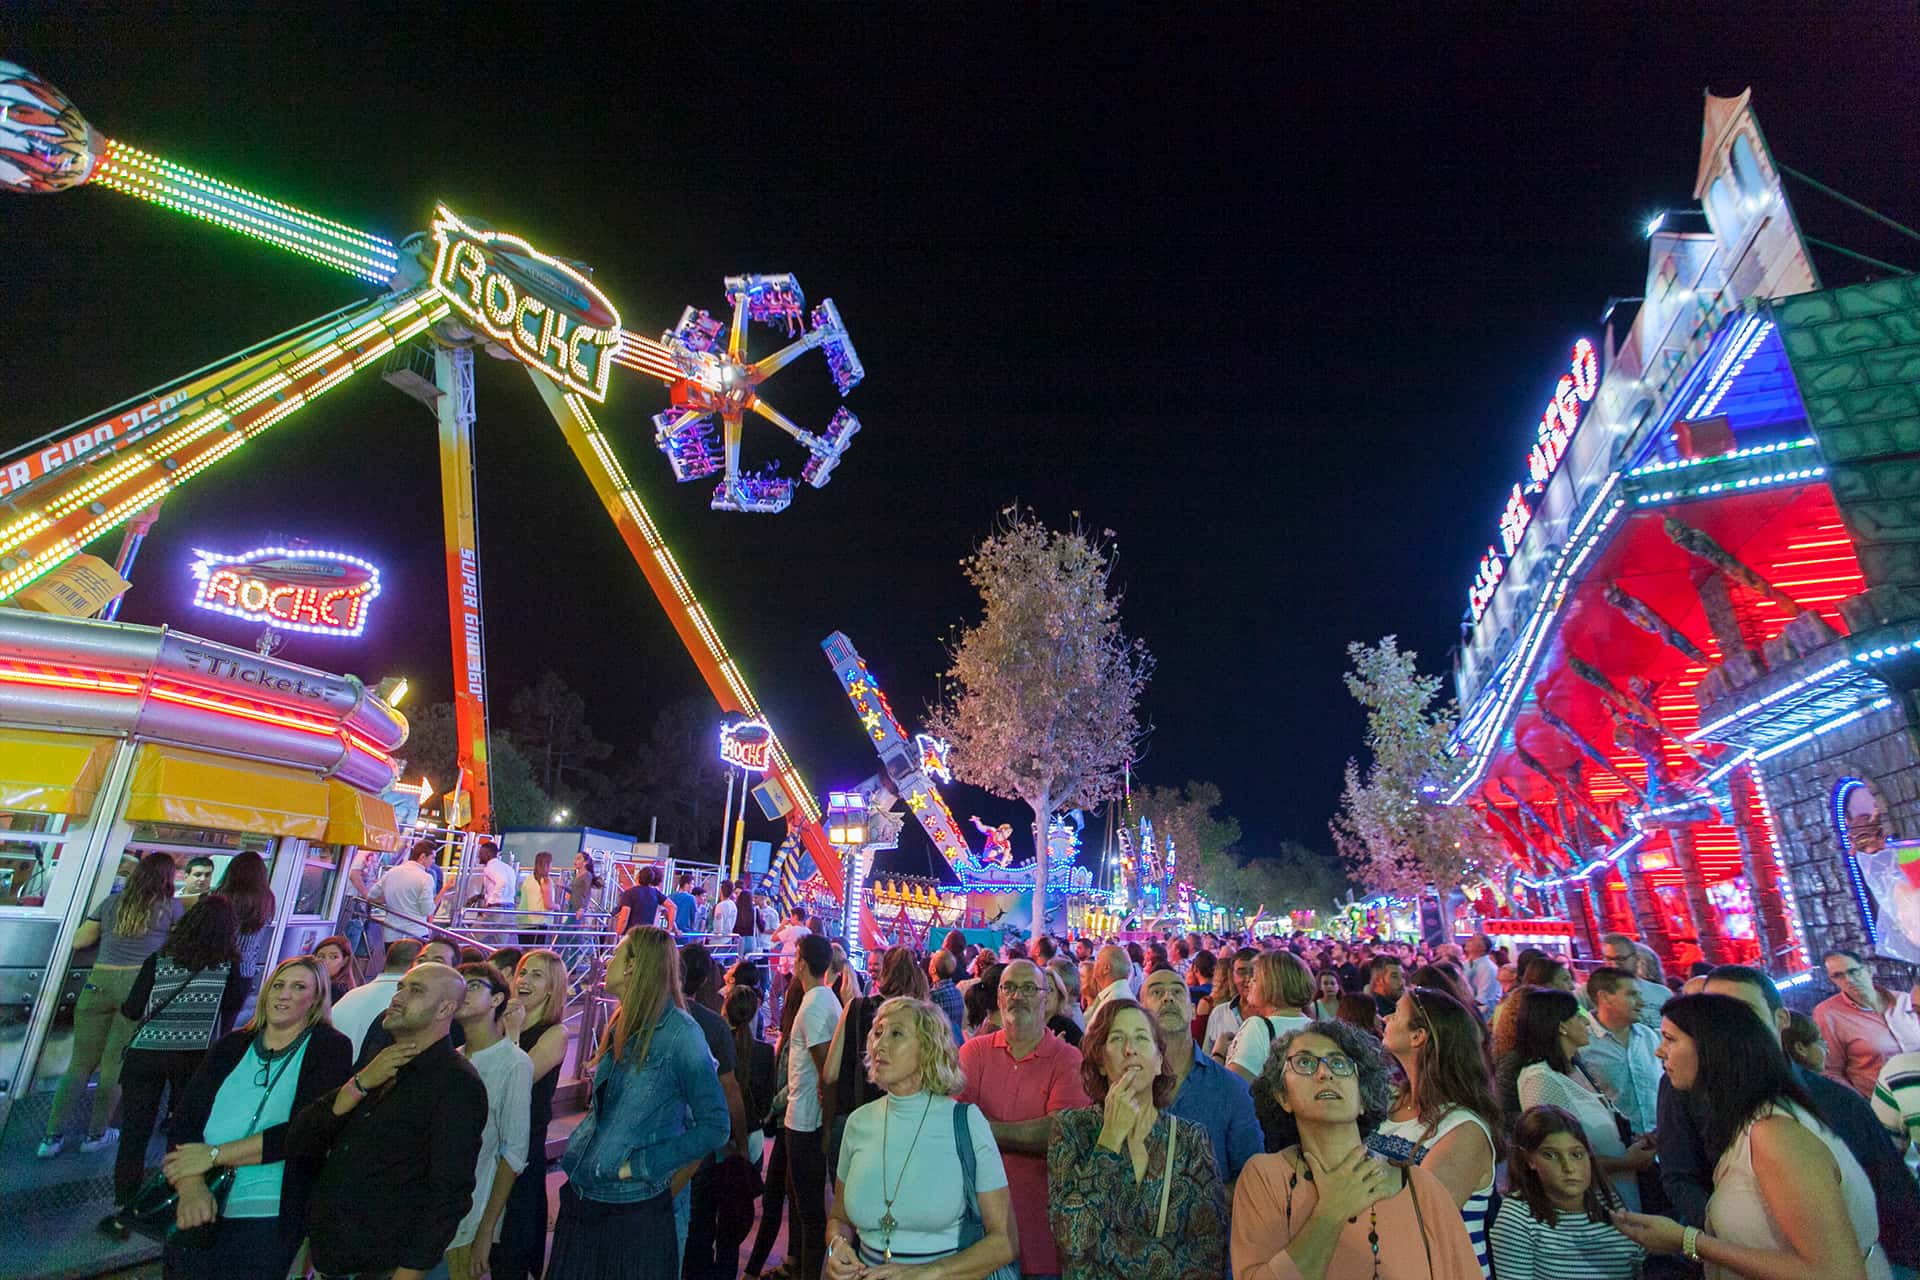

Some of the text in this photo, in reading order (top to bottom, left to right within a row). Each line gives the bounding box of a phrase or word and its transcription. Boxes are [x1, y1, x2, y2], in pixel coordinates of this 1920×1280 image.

[460, 547, 478, 608] SUPER
[464, 613, 481, 659] GIRO
[1485, 921, 1569, 933] TAQUILLA
